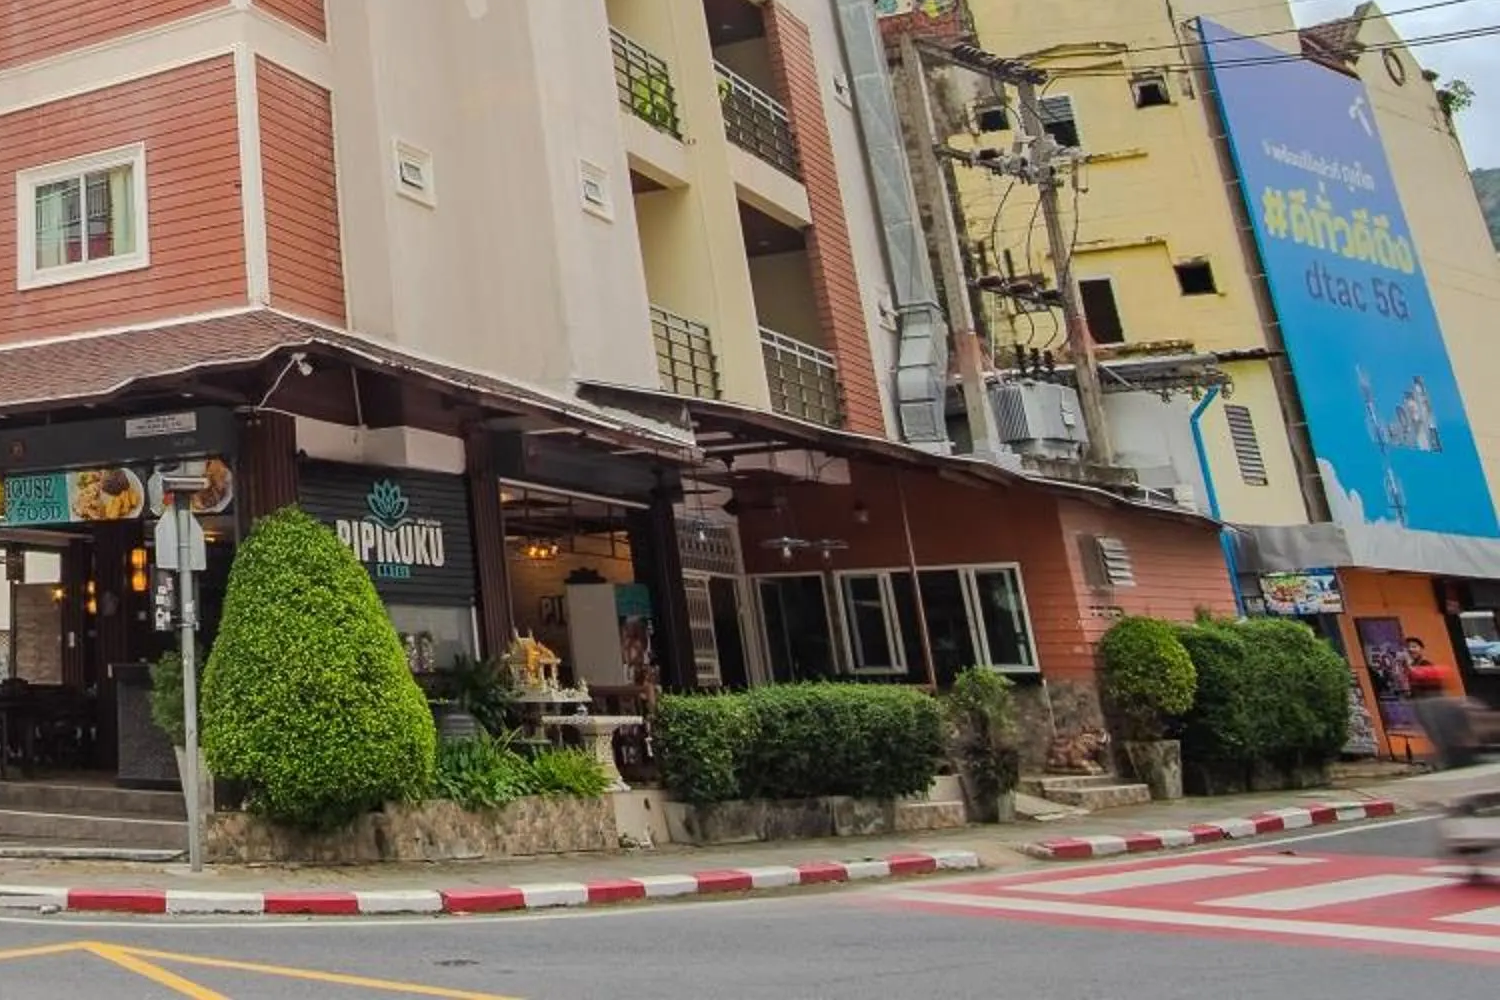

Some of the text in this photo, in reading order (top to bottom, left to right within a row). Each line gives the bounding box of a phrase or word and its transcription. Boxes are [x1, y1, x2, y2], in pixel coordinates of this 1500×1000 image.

[1305, 260, 1409, 321] dtac 5G
[16, 504, 63, 522] FOOD
[336, 519, 445, 567] PIPIKUKU
